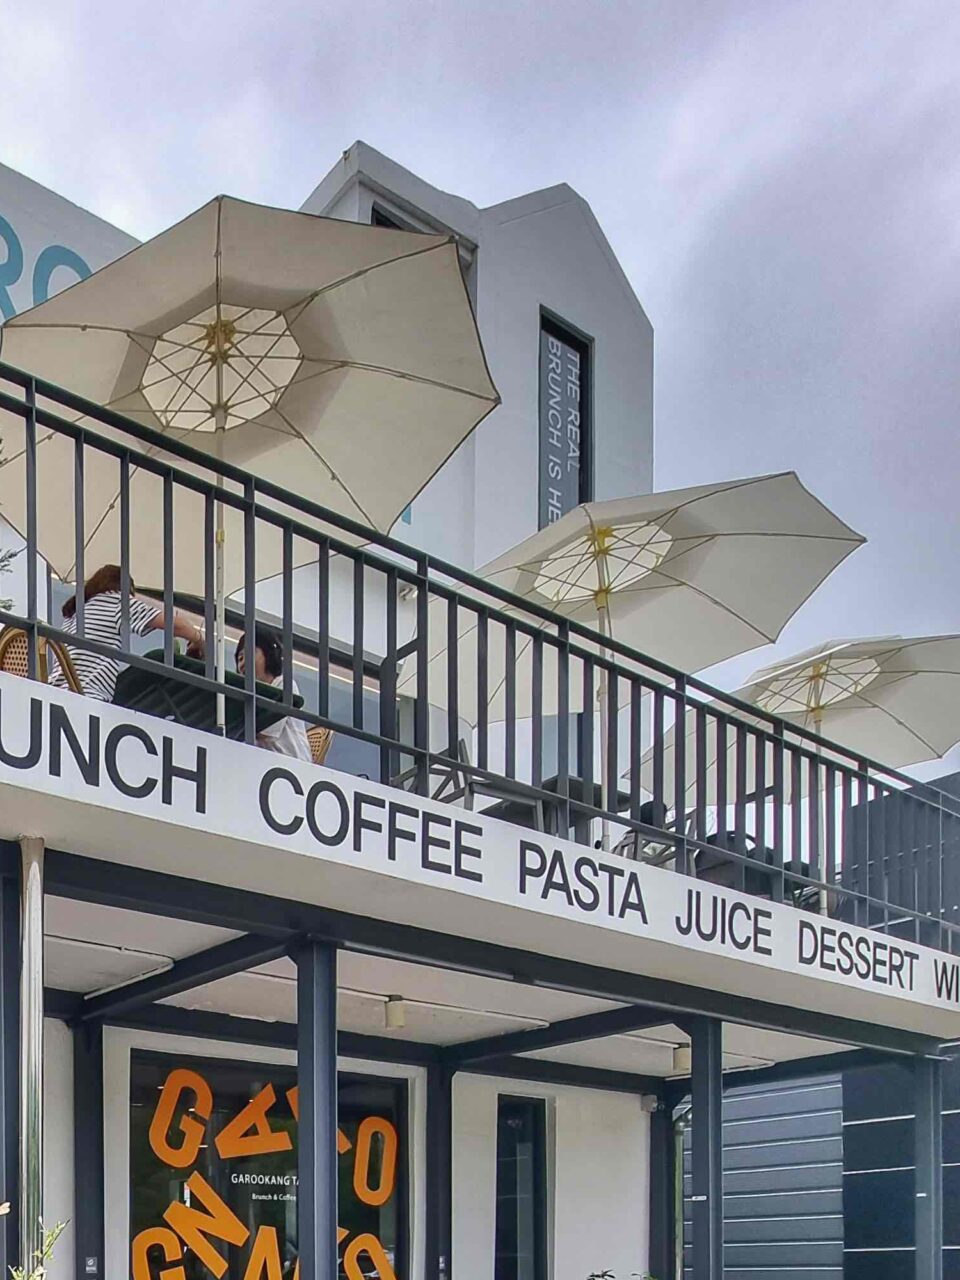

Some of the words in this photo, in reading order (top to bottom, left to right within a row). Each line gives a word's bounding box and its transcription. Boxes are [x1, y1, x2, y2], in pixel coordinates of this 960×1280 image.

[548, 336, 562, 448] BRUNCH
[567, 350, 581, 399] THE
[548, 454, 562, 481] IS
[567, 406, 581, 473] REAL
[259, 767, 484, 884] COFFEE
[519, 839, 648, 926] PASTA
[675, 888, 773, 957] JUICE
[798, 919, 919, 992] DESSERT
[231, 1173, 290, 1186] GAROOKANG
